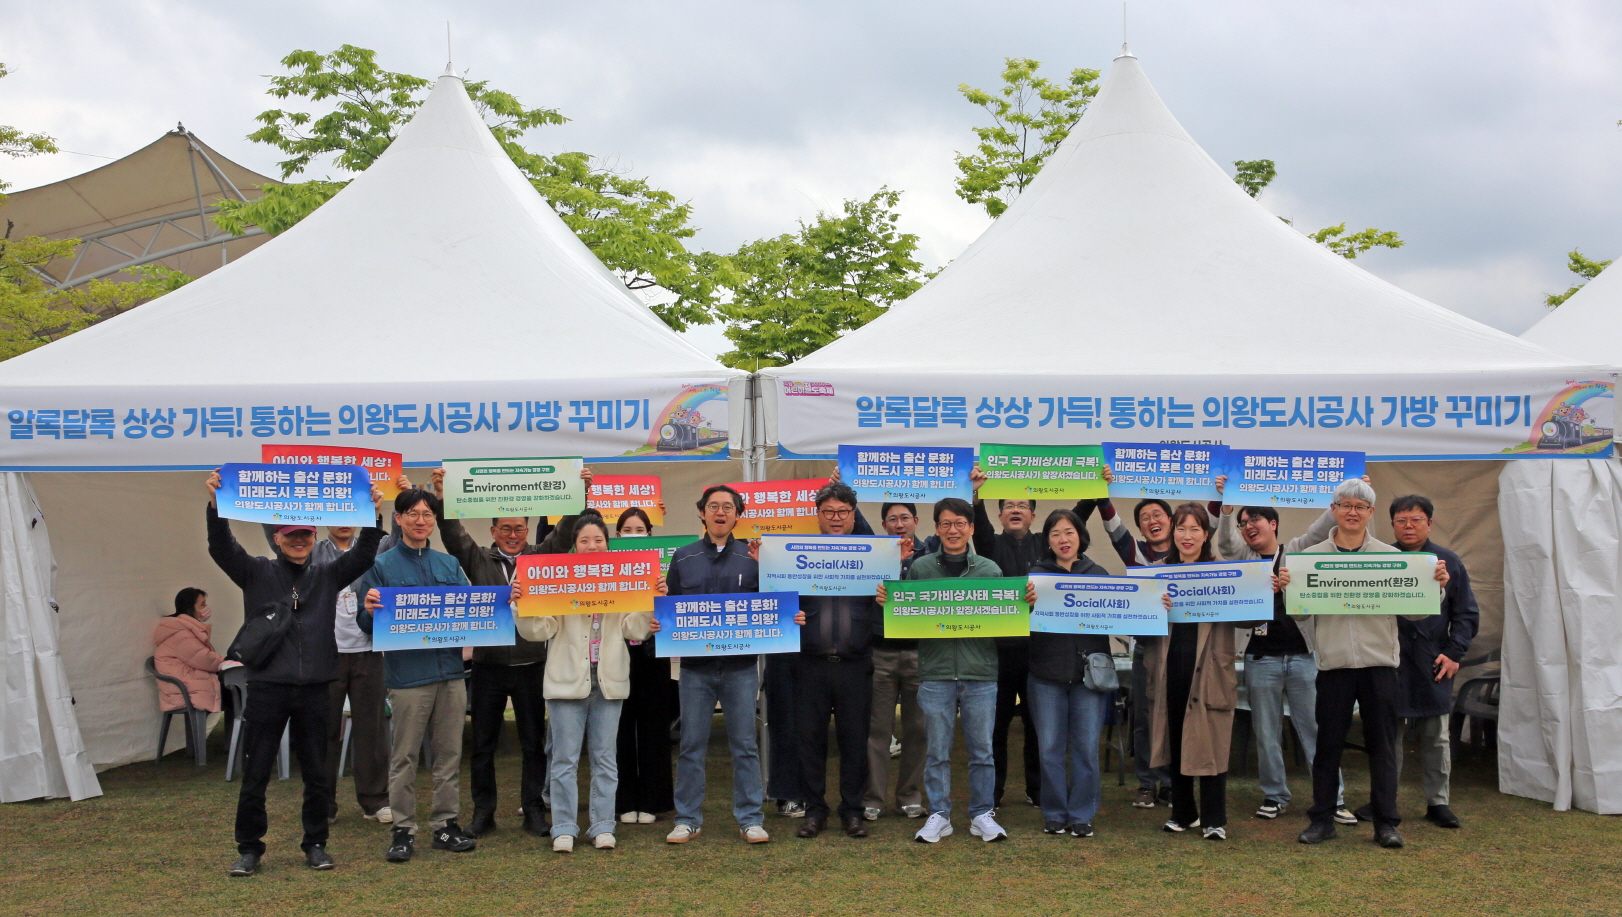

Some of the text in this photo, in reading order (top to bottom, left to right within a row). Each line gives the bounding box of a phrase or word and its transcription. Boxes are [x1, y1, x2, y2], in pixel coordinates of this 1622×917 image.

[855, 396, 1531, 428] 알록달록 상상 가득! 통하는 의왕도시공사 가방 꾸미기
[7, 399, 650, 440] 알록달록 상상 가득! 통하는 의왕도시공사 가방 꾸미기
[857, 451, 953, 465] 함께하는 출산 문화!
[987, 455, 1098, 468] 인구 국가비상사태 극복!
[1115, 448, 1210, 462] 함께하는 출산 문화!
[361, 456, 391, 468] 세상!
[1114, 461, 1209, 475] 미래도시 푸른 의왕!
[1244, 456, 1344, 469] 함께하는 출산 문화!
[238, 470, 352, 484] 함께하는 출산 문화!
[857, 465, 953, 478] 미래도시 푸른 의왕!
[986, 470, 1099, 480] 의왕도시공사가 앞장서겠습니다.
[1244, 469, 1344, 483] 미래도시 푸른 의왕!
[463, 479, 566, 493] Environment(환경)
[853, 479, 958, 490] 의왕도시공사가 함께 합니다.
[1111, 475, 1213, 487] 의왕도시공사가 함께 합니다.
[238, 487, 351, 499] 미래도시 푸른 의왕!
[591, 484, 625, 496] 행복한
[629, 484, 656, 496] 세상!
[1033, 486, 1065, 494] 의왕도시공사
[1239, 484, 1298, 494] 의왕도시공사가
[1299, 485, 1317, 494] 함께
[753, 490, 792, 504] 행복한
[892, 492, 926, 500] 의왕도시공사
[1279, 497, 1314, 505] 의왕도시공사
[234, 501, 356, 512] 의왕도시공사가 함께 합니다.
[612, 500, 628, 508] 함께
[630, 500, 656, 508] 합니다.
[283, 514, 322, 522] 의왕도시공사
[776, 507, 794, 518] 함께
[796, 554, 864, 570] Social(사회)
[527, 565, 568, 580] 아이와
[573, 563, 614, 579] 행복한
[619, 562, 650, 577] 세상!
[1306, 573, 1419, 588] Environment(환경)
[528, 580, 650, 596] 의왕도시공사와 함께 합니다.
[1167, 583, 1236, 598] Social(사회)
[395, 592, 496, 606] 함께하는 출산 문화!
[893, 589, 1019, 603] 인구 국가비상사태 극복!
[1063, 593, 1130, 609] Social(사회)
[579, 599, 615, 608] 의왕도시공사
[675, 599, 777, 614] 함께하는 출산 문화!
[893, 604, 1020, 616] 의왕도시공사가 앞장서겠습니다.
[394, 605, 494, 621] 미래도시 푸른 의왕!
[390, 620, 499, 635] 의왕도시공사가 함께 합니다.
[675, 614, 778, 628] 미래도시 푸른 의왕!
[946, 624, 981, 632] 의왕도시공사
[431, 635, 465, 644] 의왕도시공사
[672, 628, 783, 642] 의왕도시공사가 함께 합니다.
[715, 643, 750, 652] 의왕도시공사
